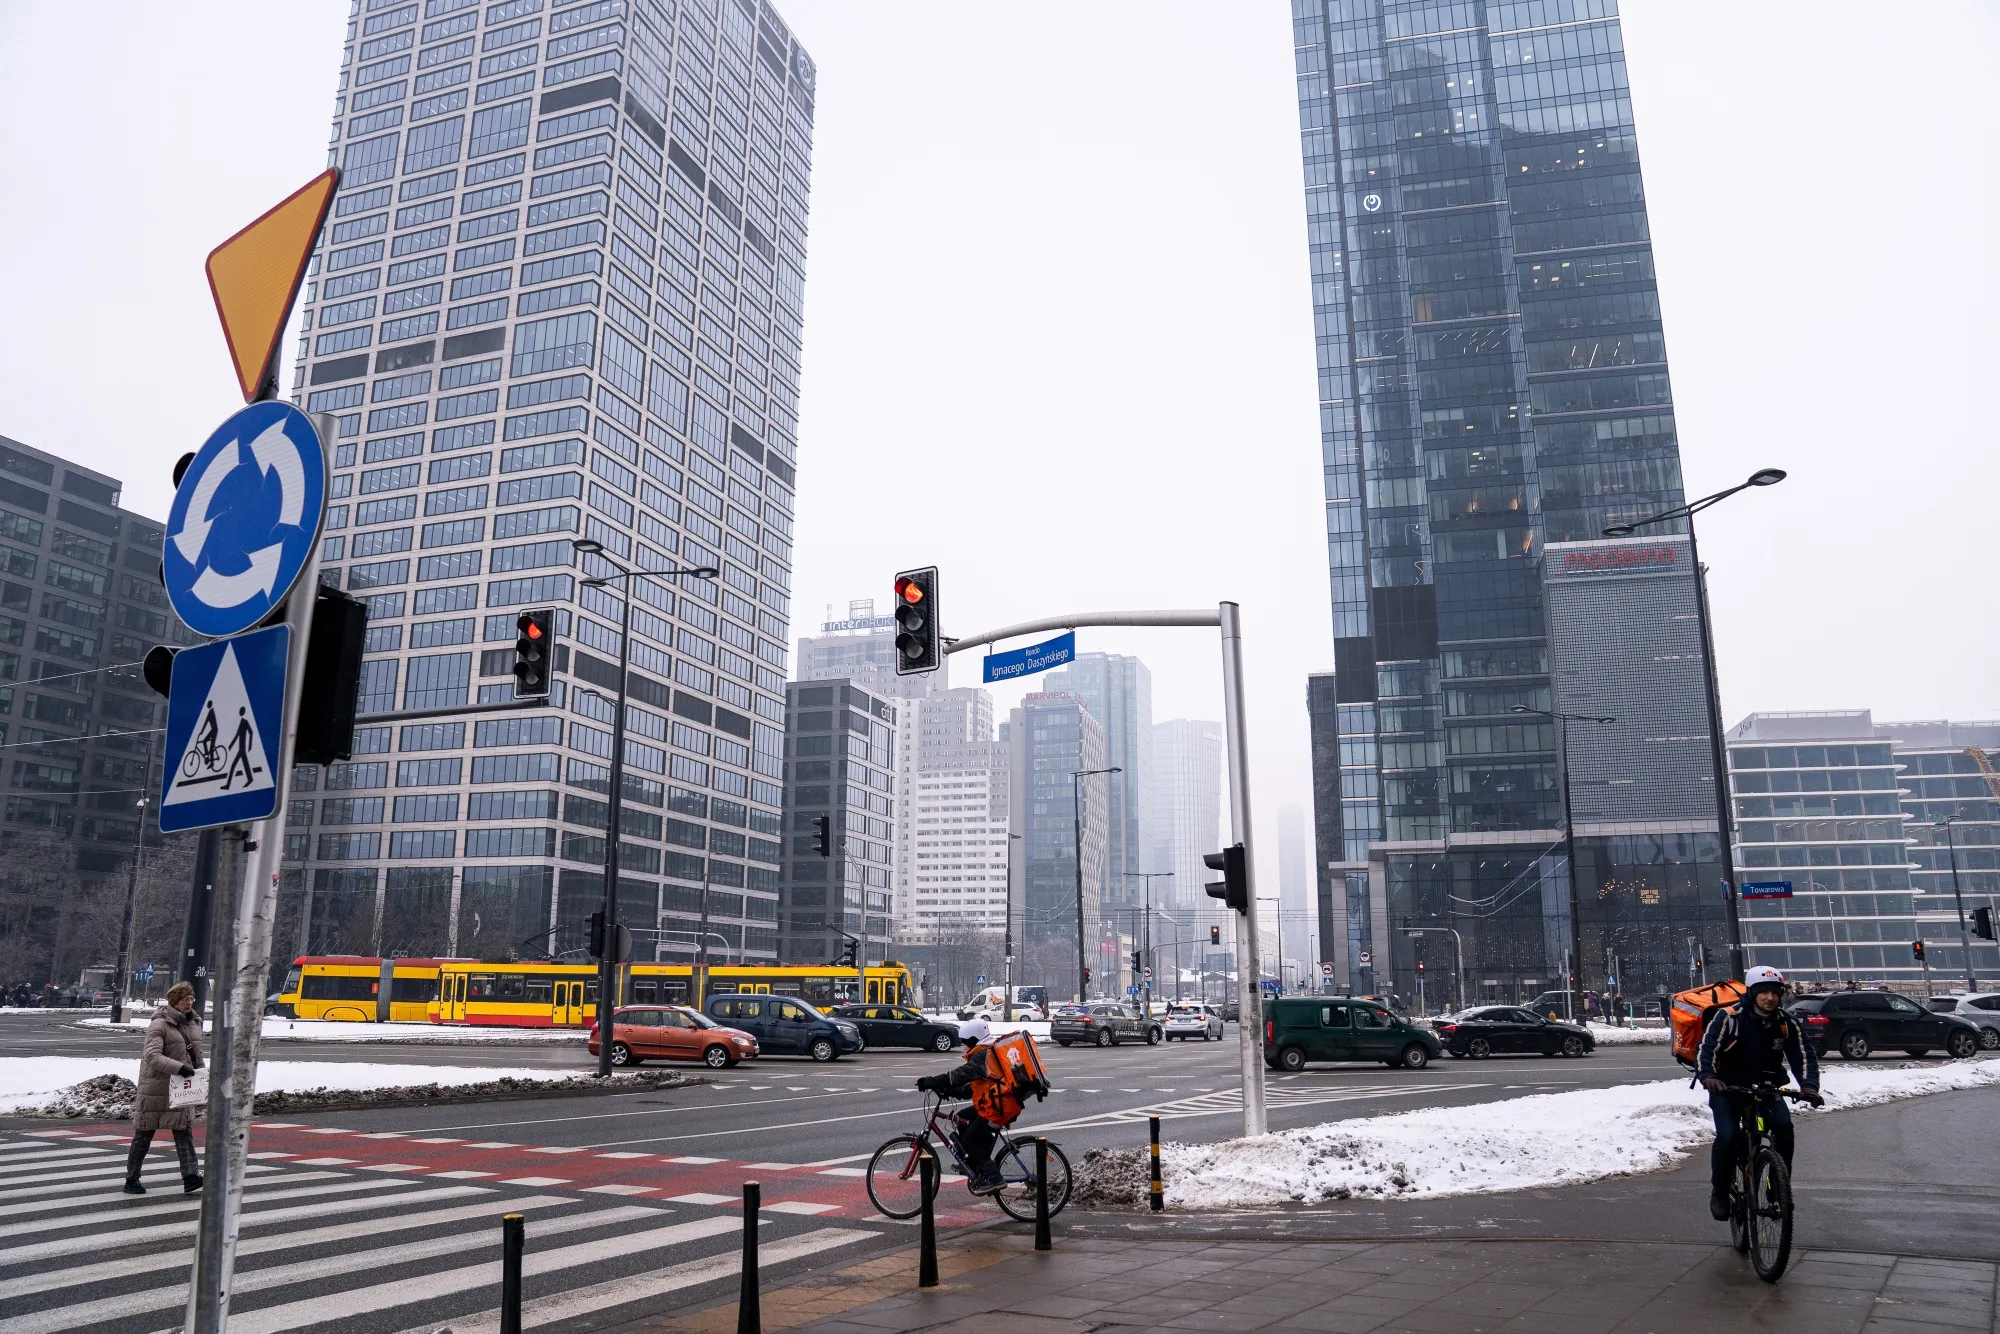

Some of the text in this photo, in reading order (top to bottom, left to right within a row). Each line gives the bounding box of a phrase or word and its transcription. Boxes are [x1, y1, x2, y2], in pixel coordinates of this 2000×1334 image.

[1564, 547, 1676, 569] moderna
[1025, 646, 1040, 657] Rondo
[991, 648, 1069, 679] Ignacego Daszyńskiego
[1026, 691, 1072, 701] MARVIPOL
[1750, 886, 1785, 894] Towarowa
